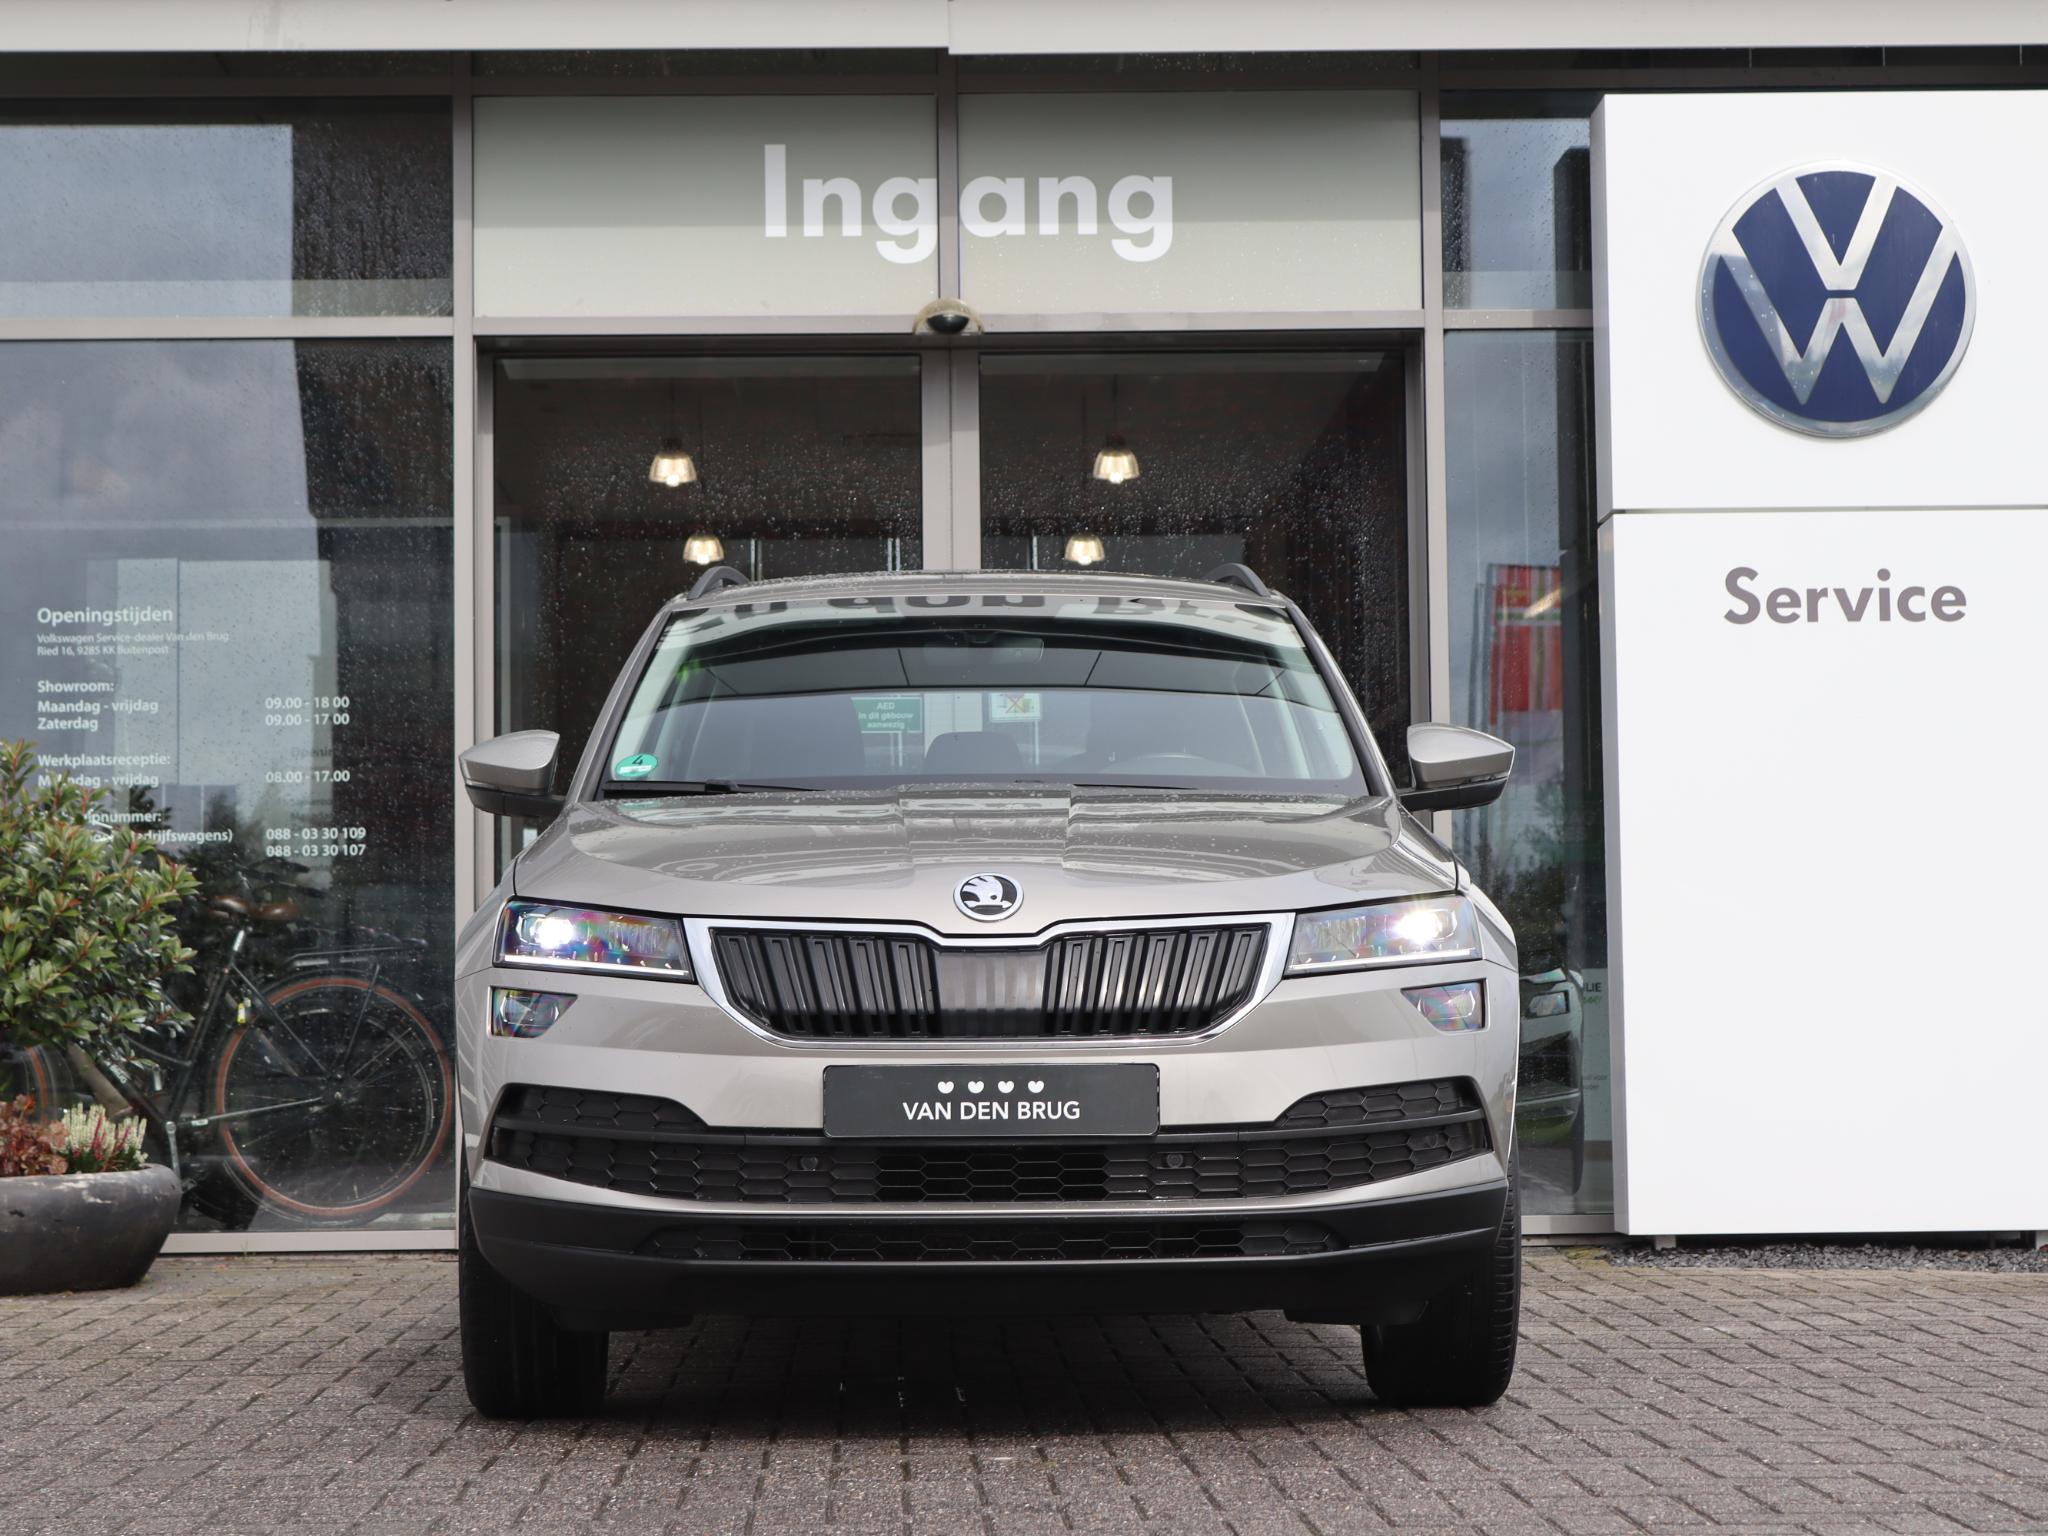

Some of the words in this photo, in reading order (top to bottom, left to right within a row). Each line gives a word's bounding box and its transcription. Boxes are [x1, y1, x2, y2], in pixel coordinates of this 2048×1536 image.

[763, 143, 1174, 265] Ingang
[1724, 566, 1967, 625] Service
[37, 607, 173, 627] Openingstijden
[37, 633, 94, 645] Volkswagen
[37, 646, 59, 656] Ried
[37, 680, 115, 693] Showroom:
[37, 700, 101, 715] Maandag
[111, 699, 159, 714] vrijdag
[264, 697, 302, 709] 09.00
[876, 702, 896, 710] AED
[37, 717, 99, 732] Zaterdag
[264, 714, 302, 726] 09.00
[37, 753, 172, 768] Werkplaatsreceptie:
[37, 773, 101, 789] Mndag
[112, 773, 160, 788] vrijdag
[265, 771, 303, 783] 08.00
[314, 770, 351, 782] 17.00
[265, 828, 292, 840] 088
[301, 827, 319, 839] 03
[321, 827, 339, 839] 30
[341, 826, 367, 839] 109
[265, 845, 292, 857] 088
[301, 844, 319, 857] 03
[321, 844, 339, 857] 30
[341, 843, 367, 856] 107
[902, 1102, 951, 1121] VAN
[960, 1102, 1009, 1121] DEN
[1017, 1100, 1081, 1120] BRUG
